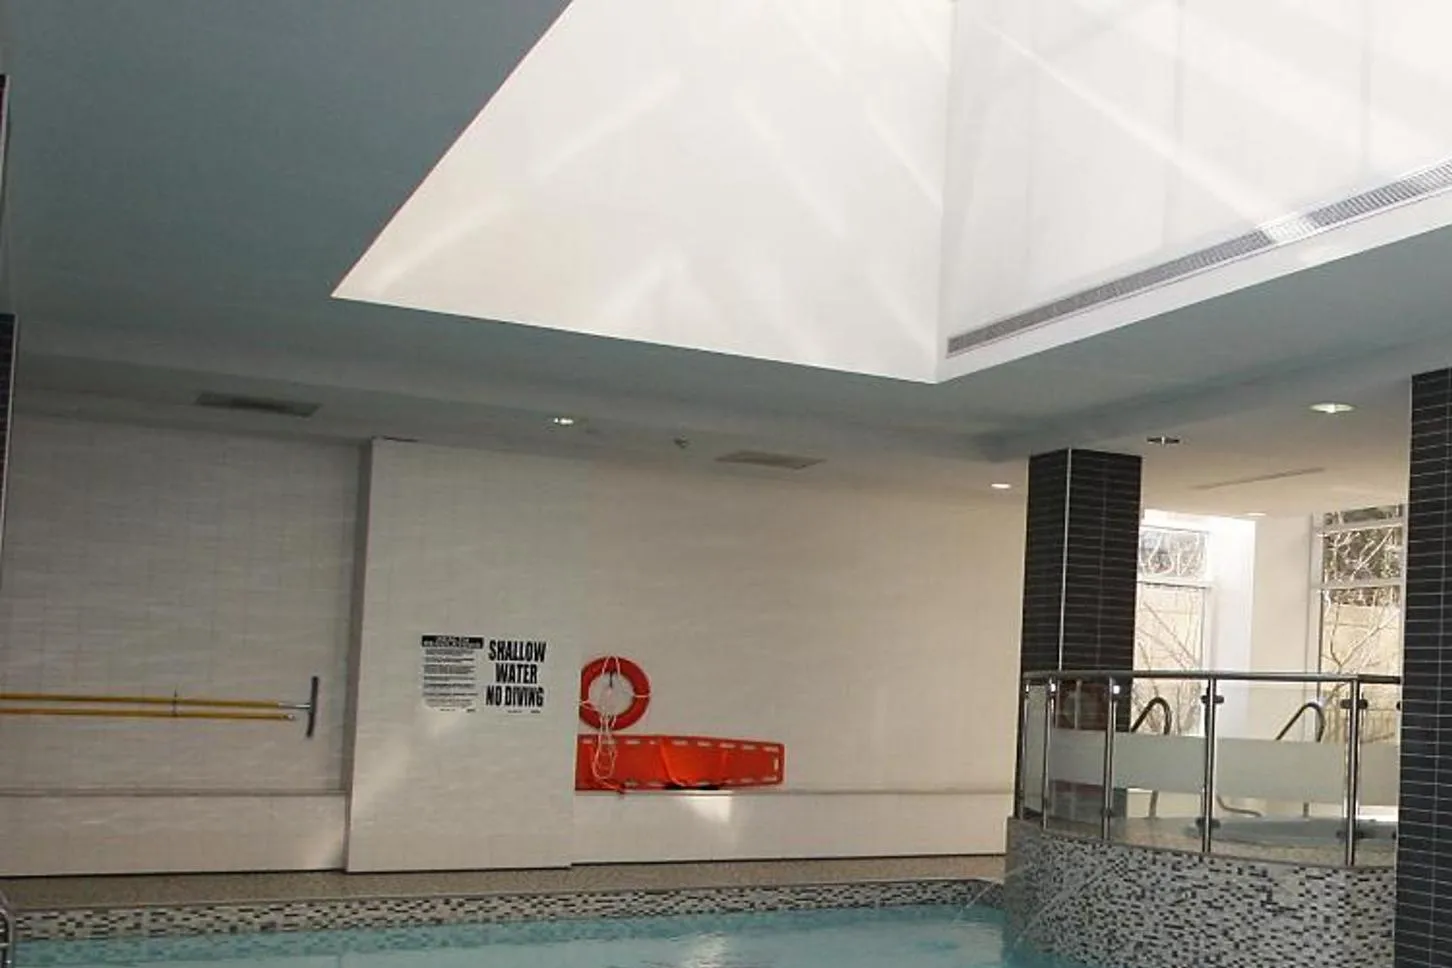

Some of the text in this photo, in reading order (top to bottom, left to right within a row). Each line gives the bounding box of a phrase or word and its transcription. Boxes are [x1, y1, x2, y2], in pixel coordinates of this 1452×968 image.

[488, 640, 547, 662] SHALLOW
[496, 663, 537, 684] WATER
[486, 685, 544, 707] NO DIVING
